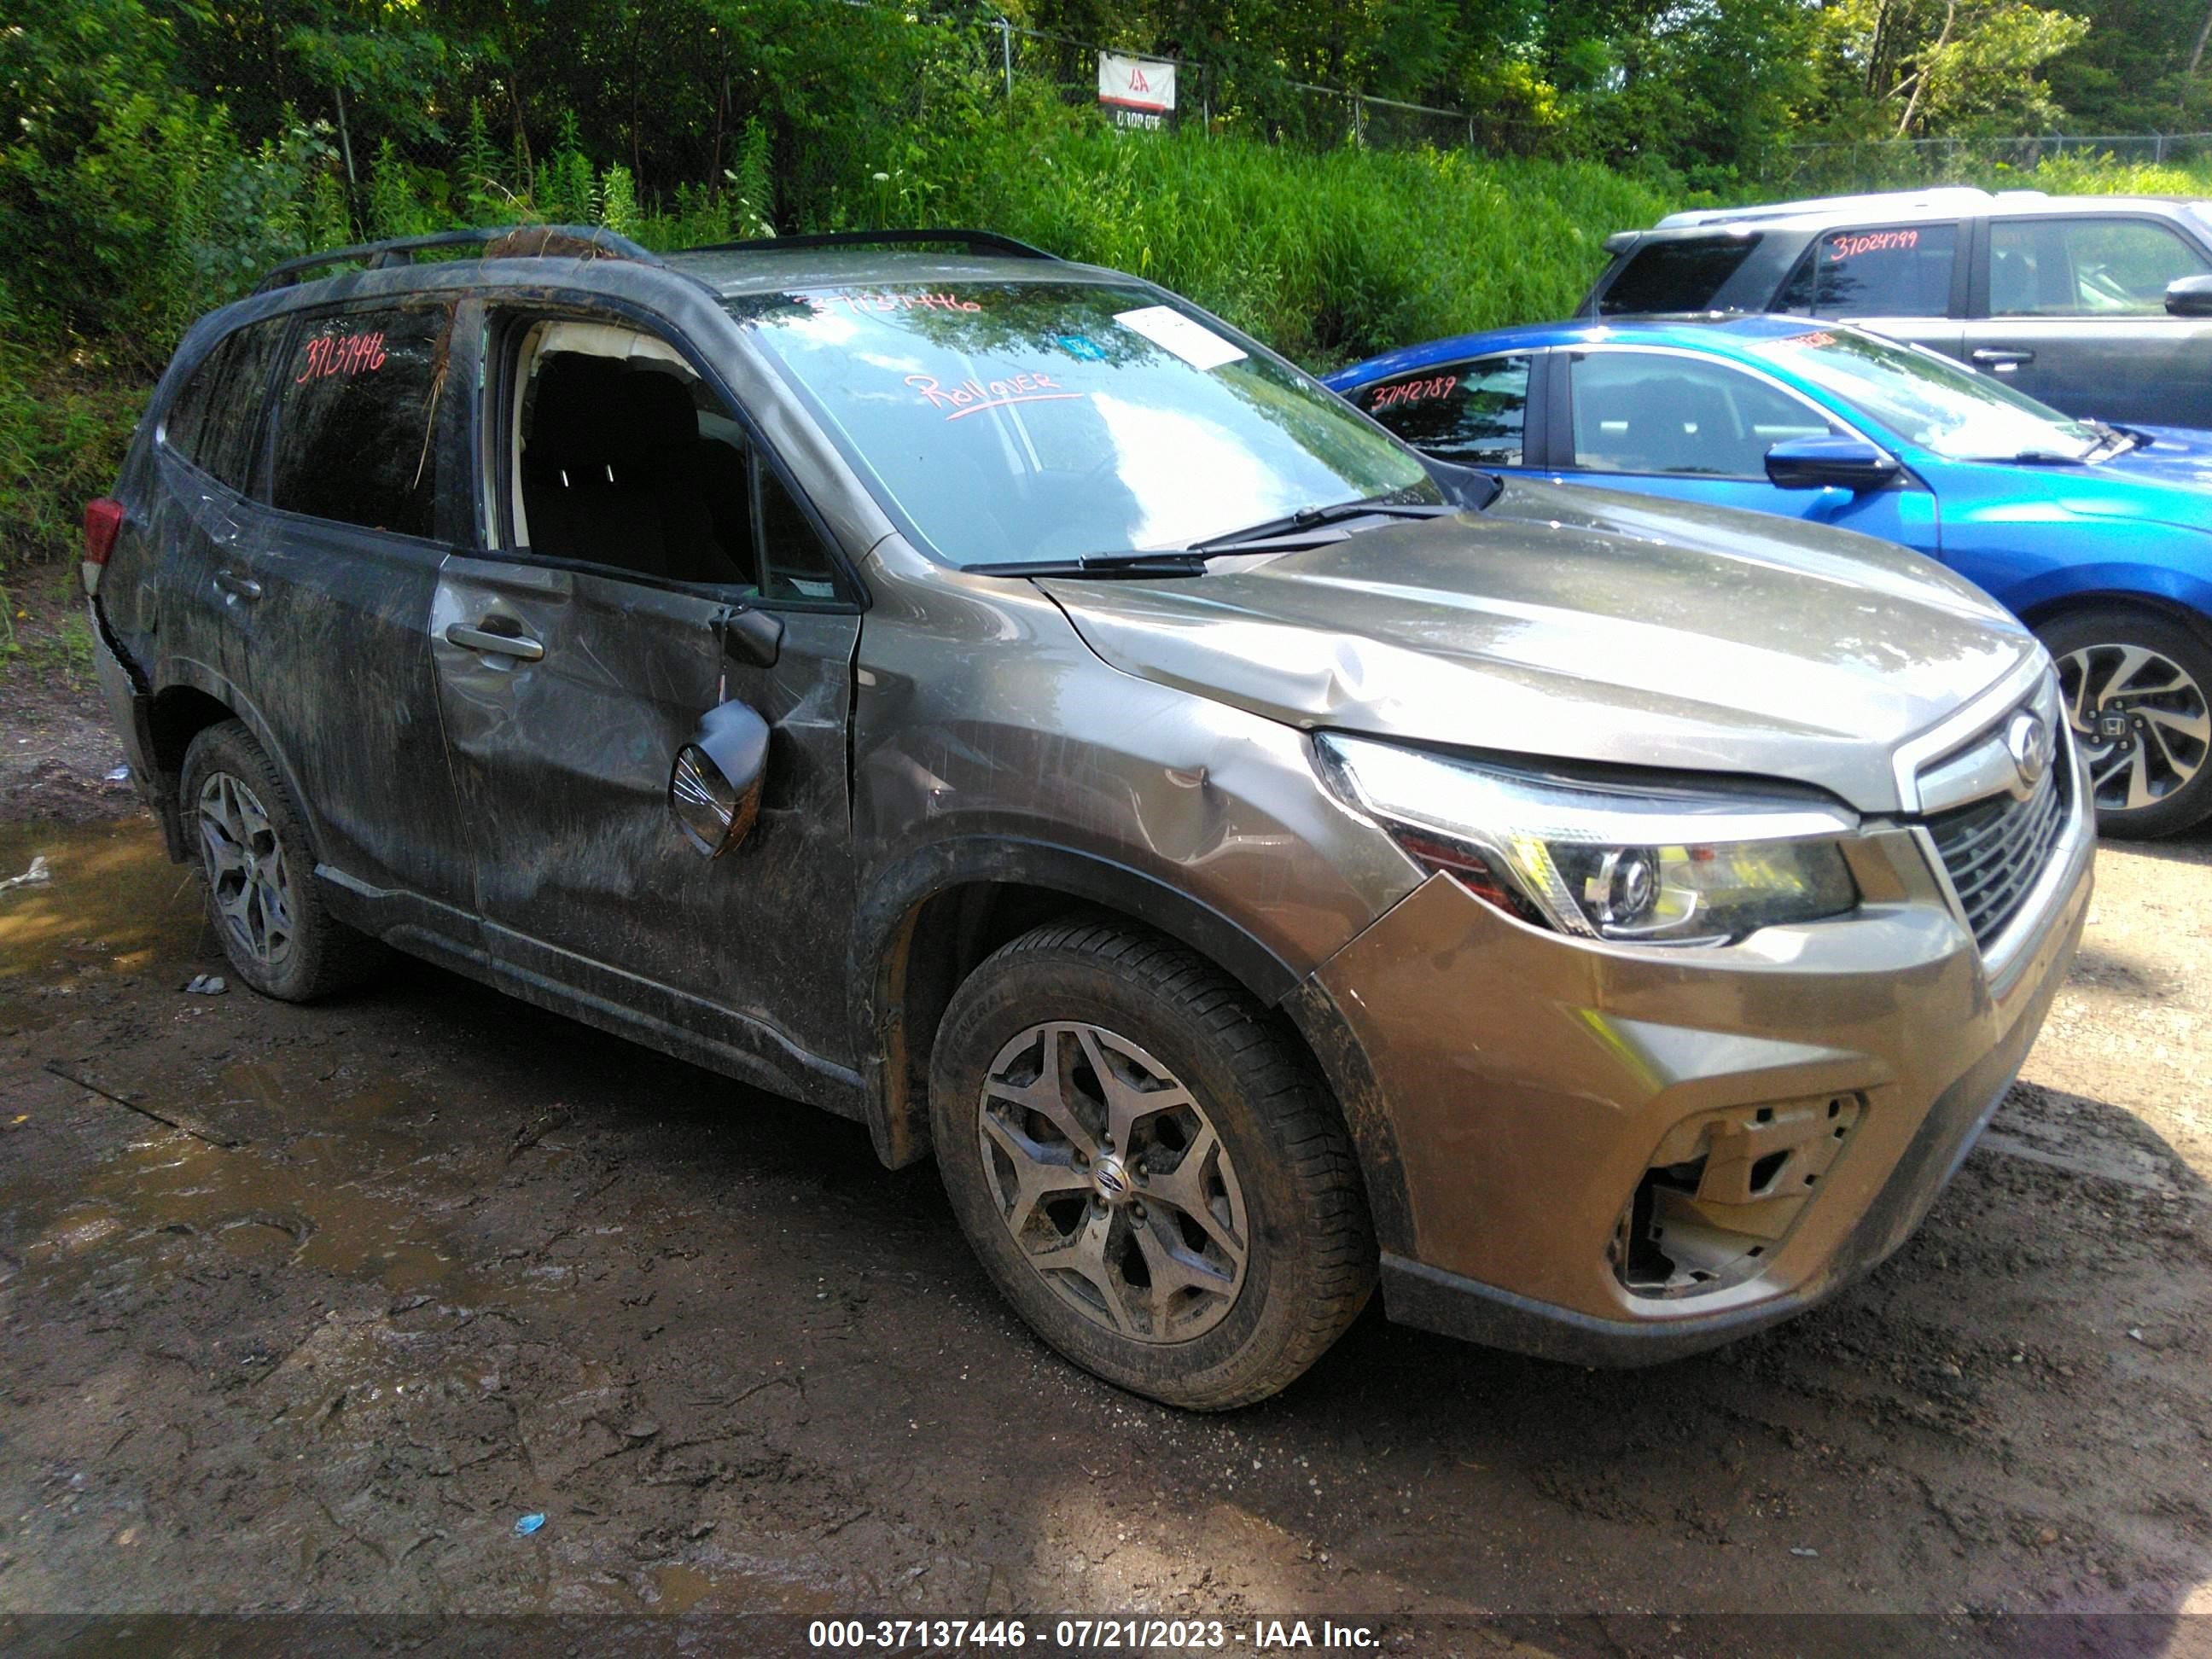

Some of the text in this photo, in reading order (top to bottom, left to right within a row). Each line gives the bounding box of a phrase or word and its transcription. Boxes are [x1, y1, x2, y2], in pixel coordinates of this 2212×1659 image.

[1116, 109, 1161, 131] DROP OFF
[1830, 230, 1918, 261] 37024799
[296, 331, 386, 383] 37137446
[1371, 375, 1457, 410] 37142789
